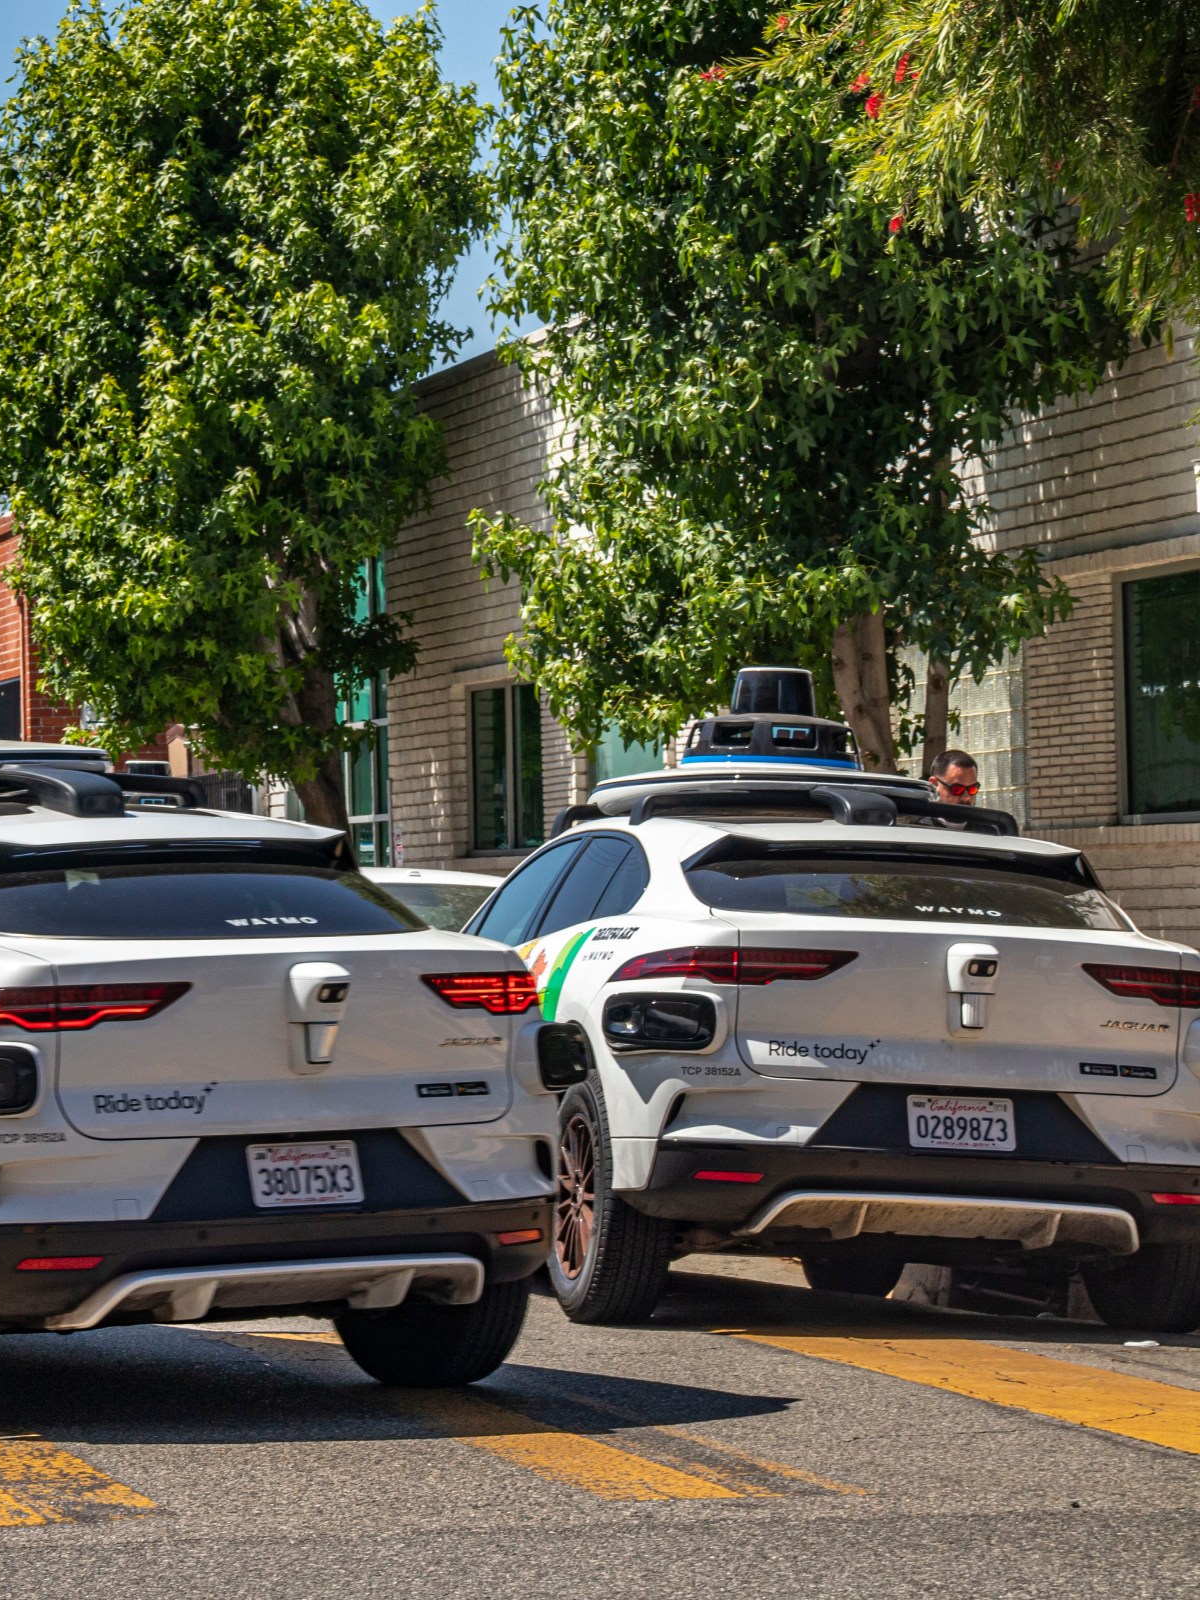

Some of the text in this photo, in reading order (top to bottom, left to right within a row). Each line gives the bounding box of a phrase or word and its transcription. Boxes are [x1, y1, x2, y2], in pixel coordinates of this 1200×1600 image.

[914, 905, 1002, 917] WAYMO
[224, 916, 319, 927] WAYMO
[589, 950, 614, 961] WAYMO
[1100, 1020, 1171, 1033] JAGUAR
[768, 1040, 869, 1065] Ride today
[680, 1066, 742, 1077] TCP 38152A
[93, 1090, 206, 1115] Ride today
[930, 1099, 994, 1115] California
[916, 1114, 1008, 1143] 02898Z3
[258, 1164, 355, 1196] 38075X3
